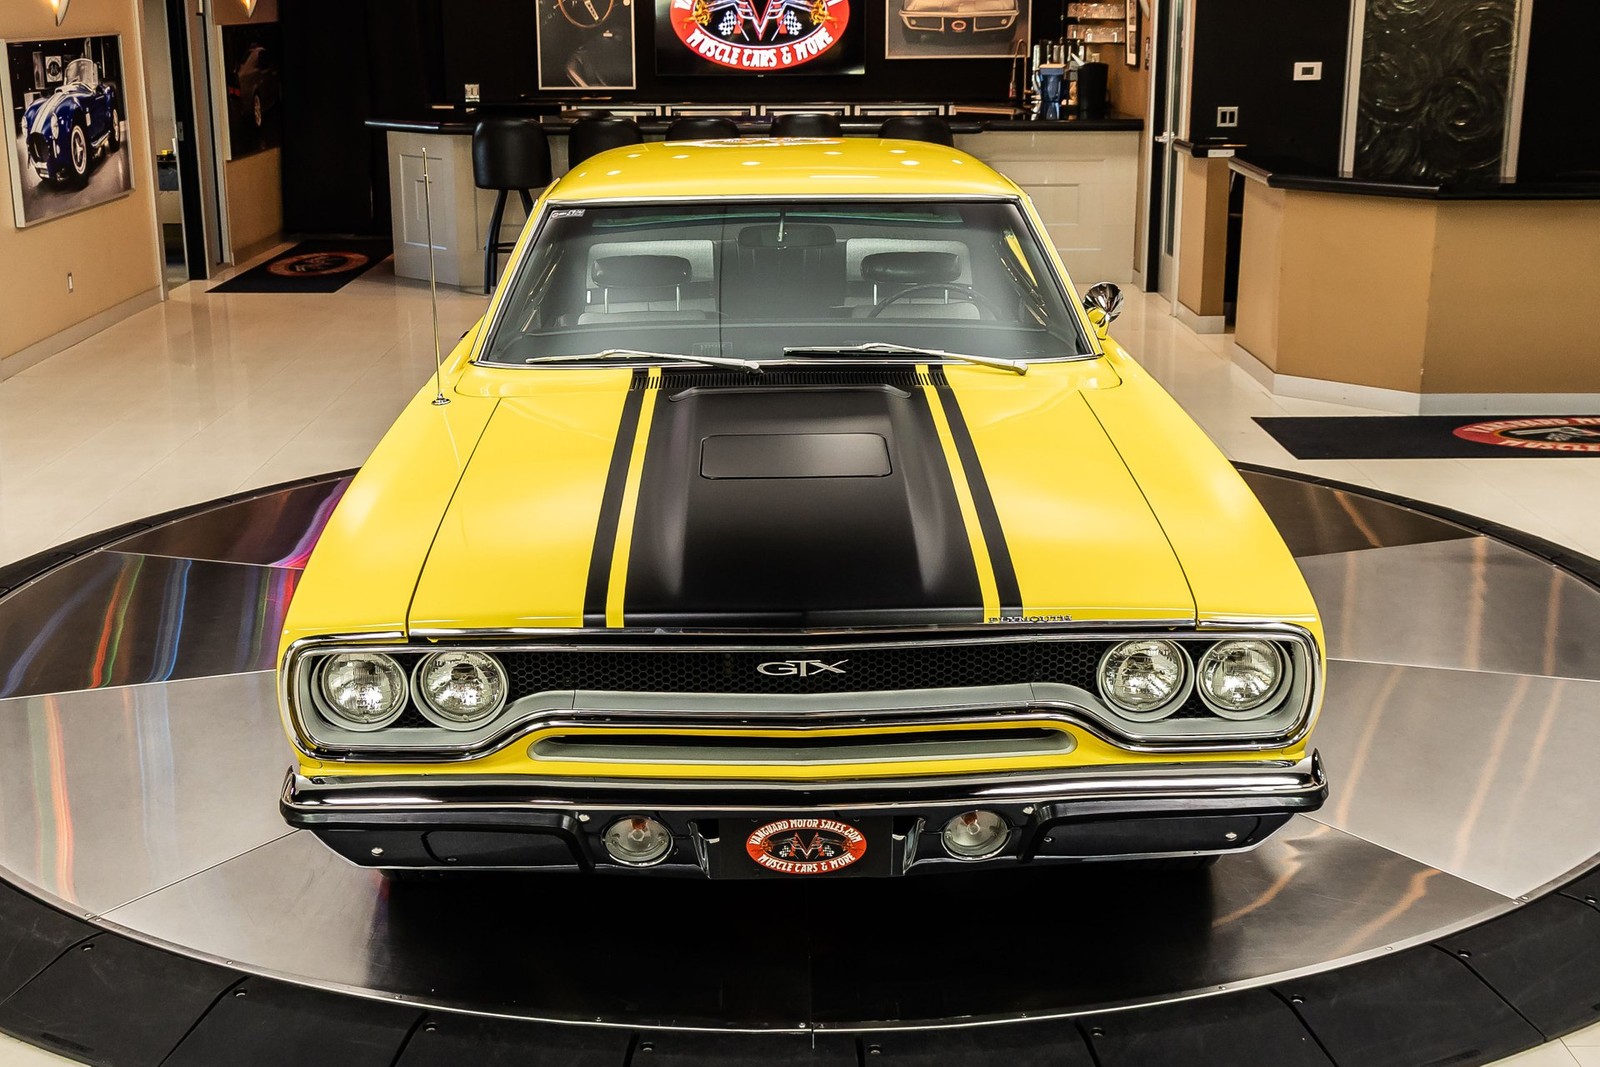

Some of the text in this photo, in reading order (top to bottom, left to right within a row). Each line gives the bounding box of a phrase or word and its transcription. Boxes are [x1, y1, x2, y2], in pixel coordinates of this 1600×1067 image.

[686, 26, 834, 68] MUSCLE CARS & MORE
[756, 659, 849, 677] GTX
[749, 818, 863, 845] VANGUARD MOTOR SALES.COM
[757, 853, 856, 873] MUSCLE CARS & MORE
